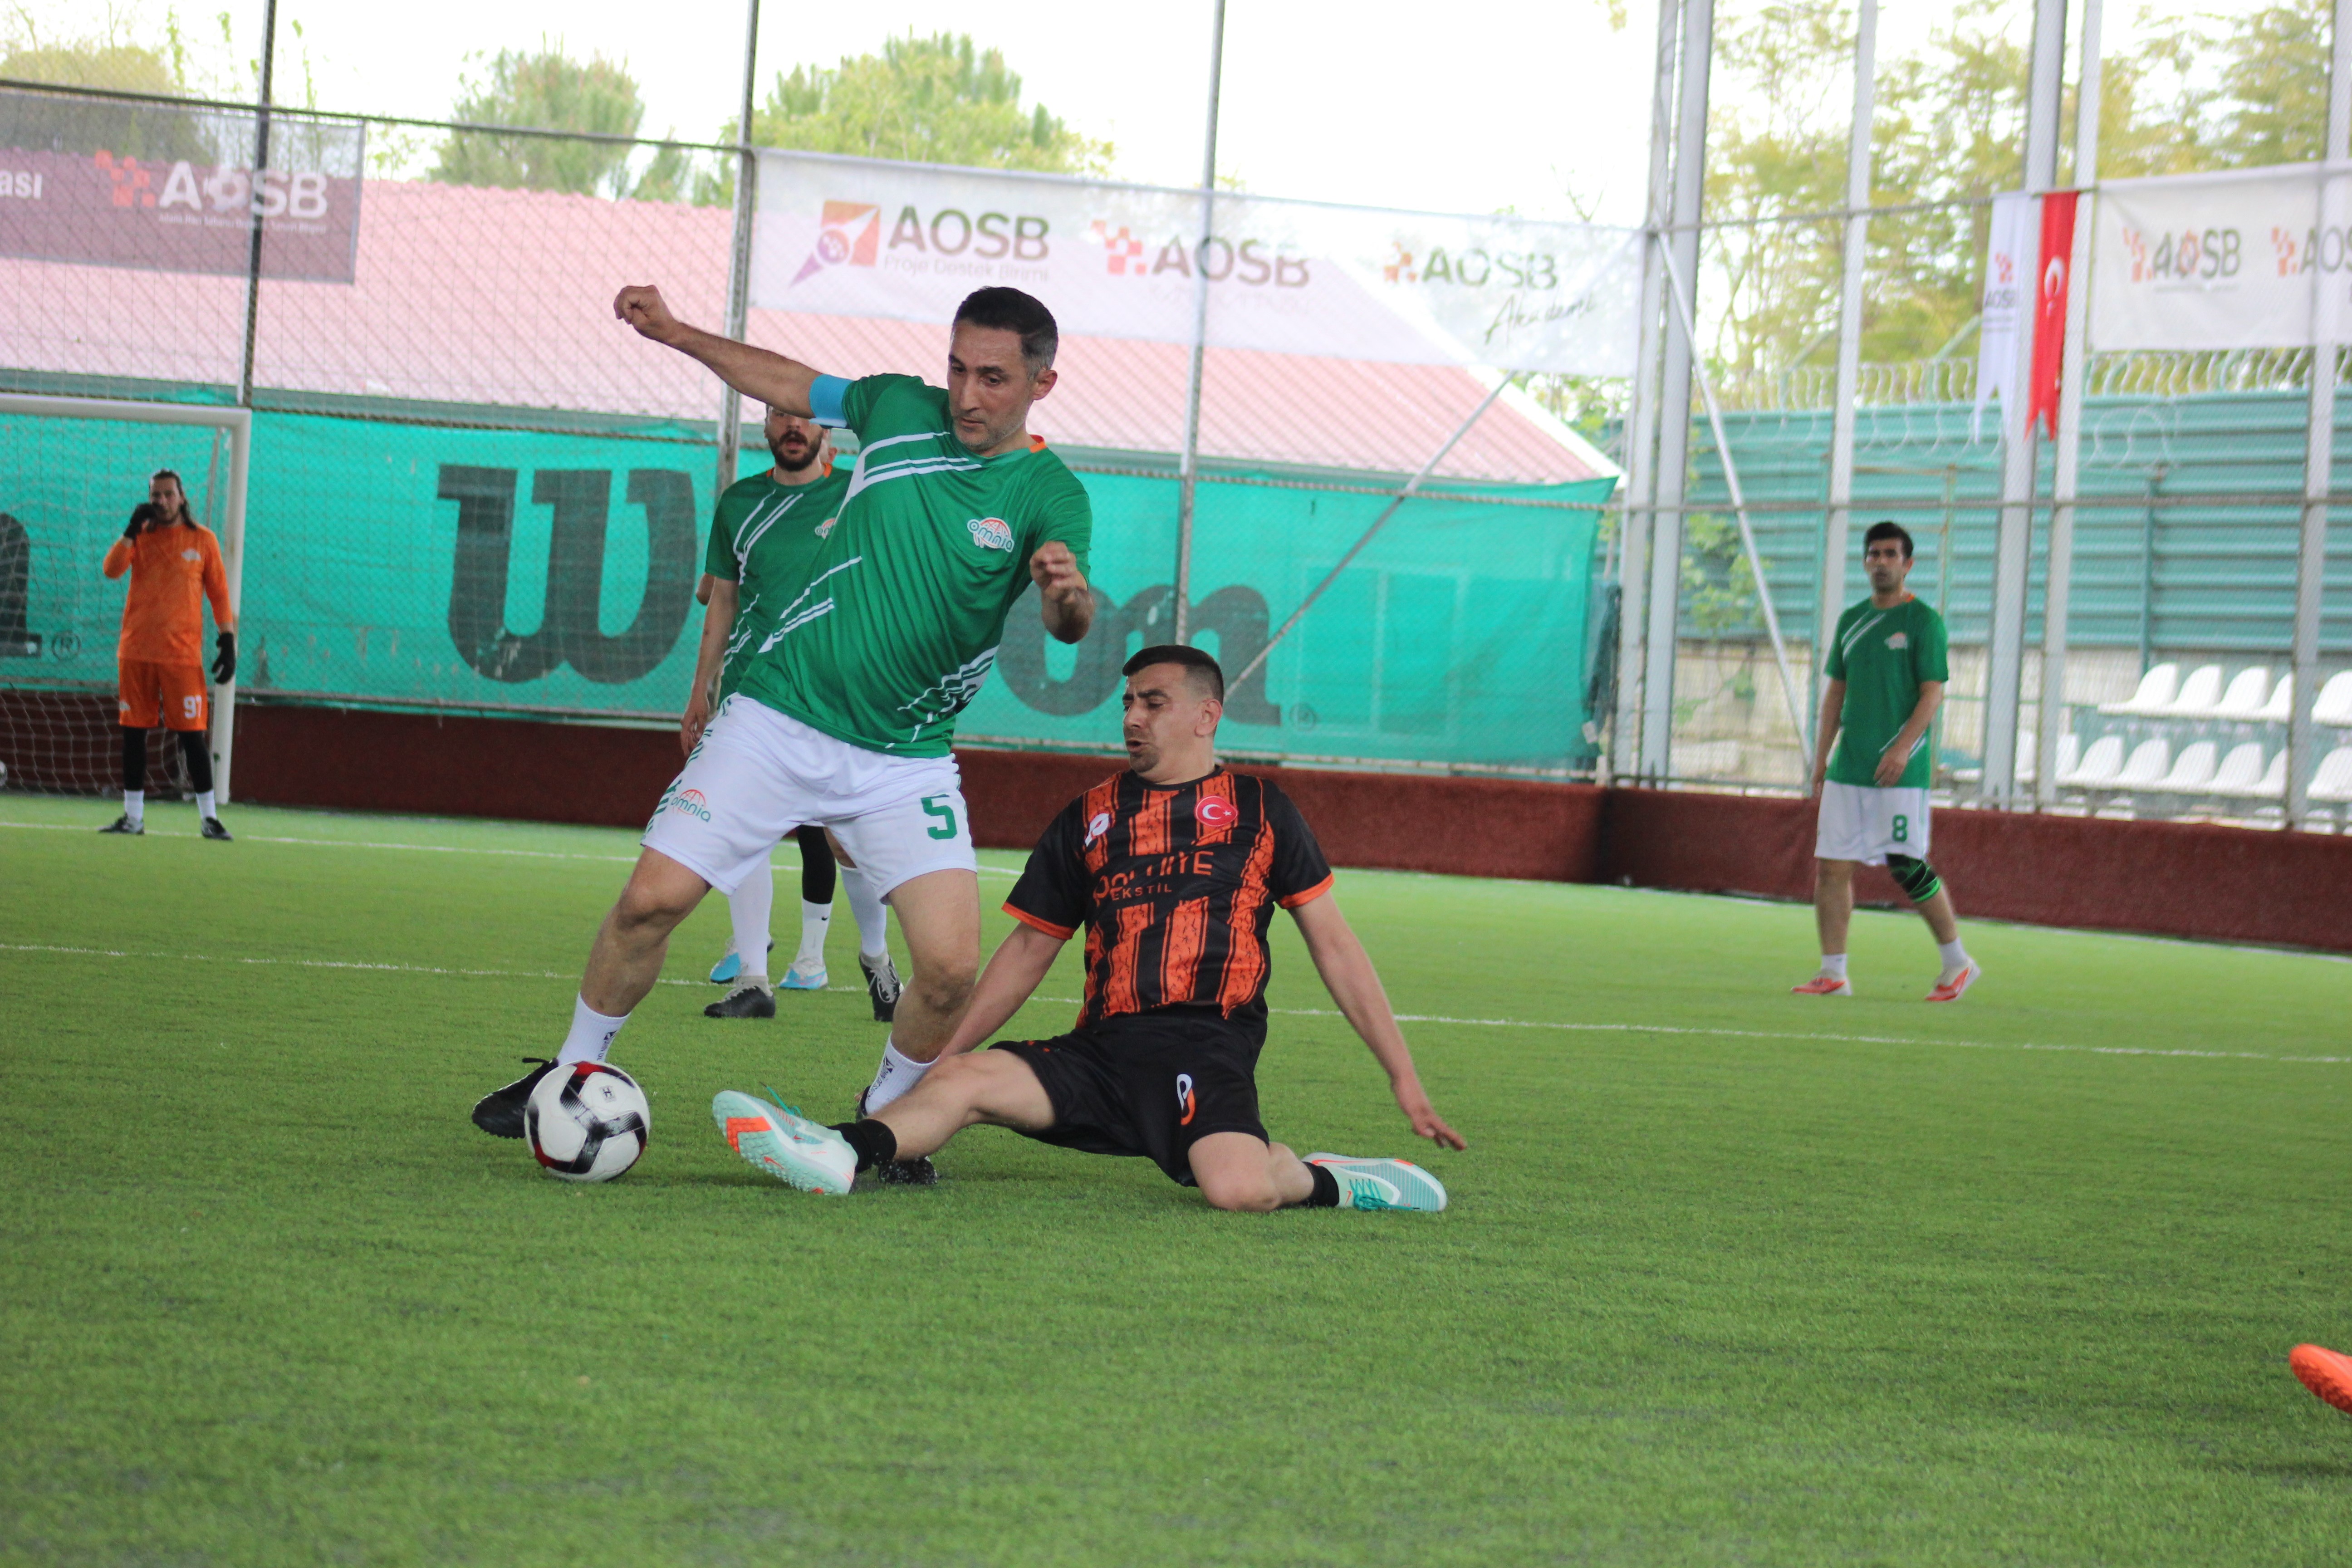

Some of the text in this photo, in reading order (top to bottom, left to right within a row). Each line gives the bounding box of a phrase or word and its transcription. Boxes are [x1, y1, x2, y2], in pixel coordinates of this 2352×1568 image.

[159, 160, 328, 218] AOSB
[889, 206, 1050, 261] AOSB
[2154, 228, 2241, 279] AOSB
[2299, 226, 2352, 274] AO
[885, 254, 929, 276] Proje
[1152, 234, 1310, 288] AOSB
[1422, 246, 1558, 289] AOSB
[968, 520, 1014, 552] omnia
[671, 797, 710, 822] omnia
[921, 794, 958, 840] 5
[1892, 814, 1907, 842] 8
